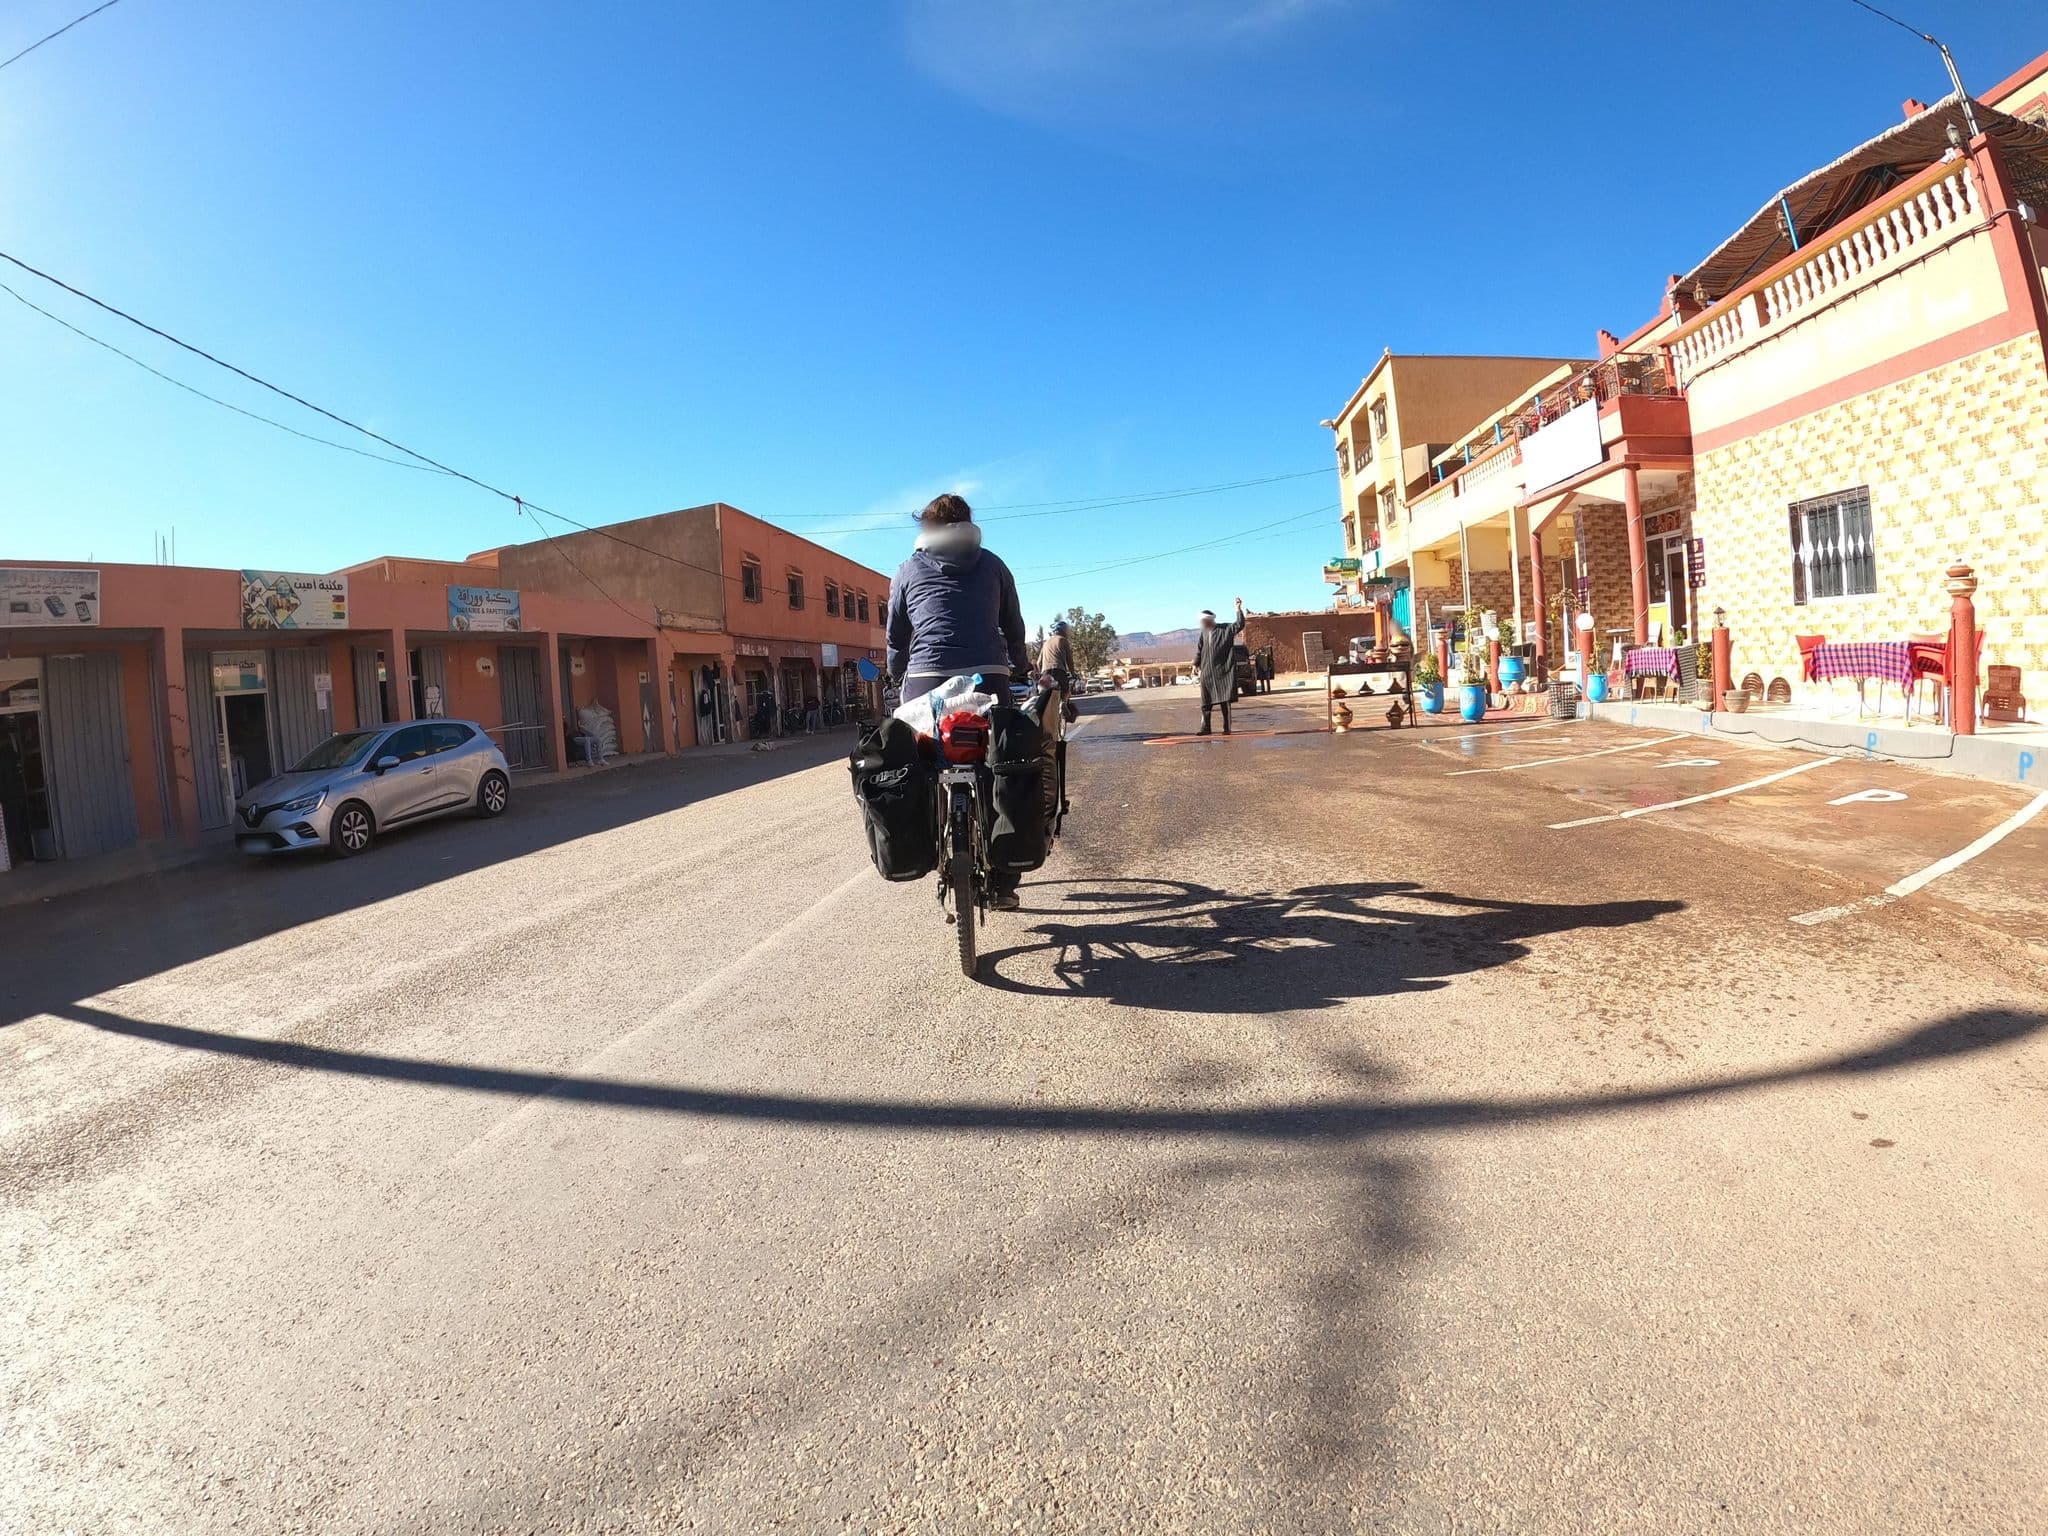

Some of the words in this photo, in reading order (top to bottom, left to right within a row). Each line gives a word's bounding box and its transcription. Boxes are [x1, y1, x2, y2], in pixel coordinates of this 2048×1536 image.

[318, 579, 344, 593] مكتبة
[1866, 732, 1878, 758] P
[2017, 751, 2034, 780] P
[1826, 788, 1909, 807] P
